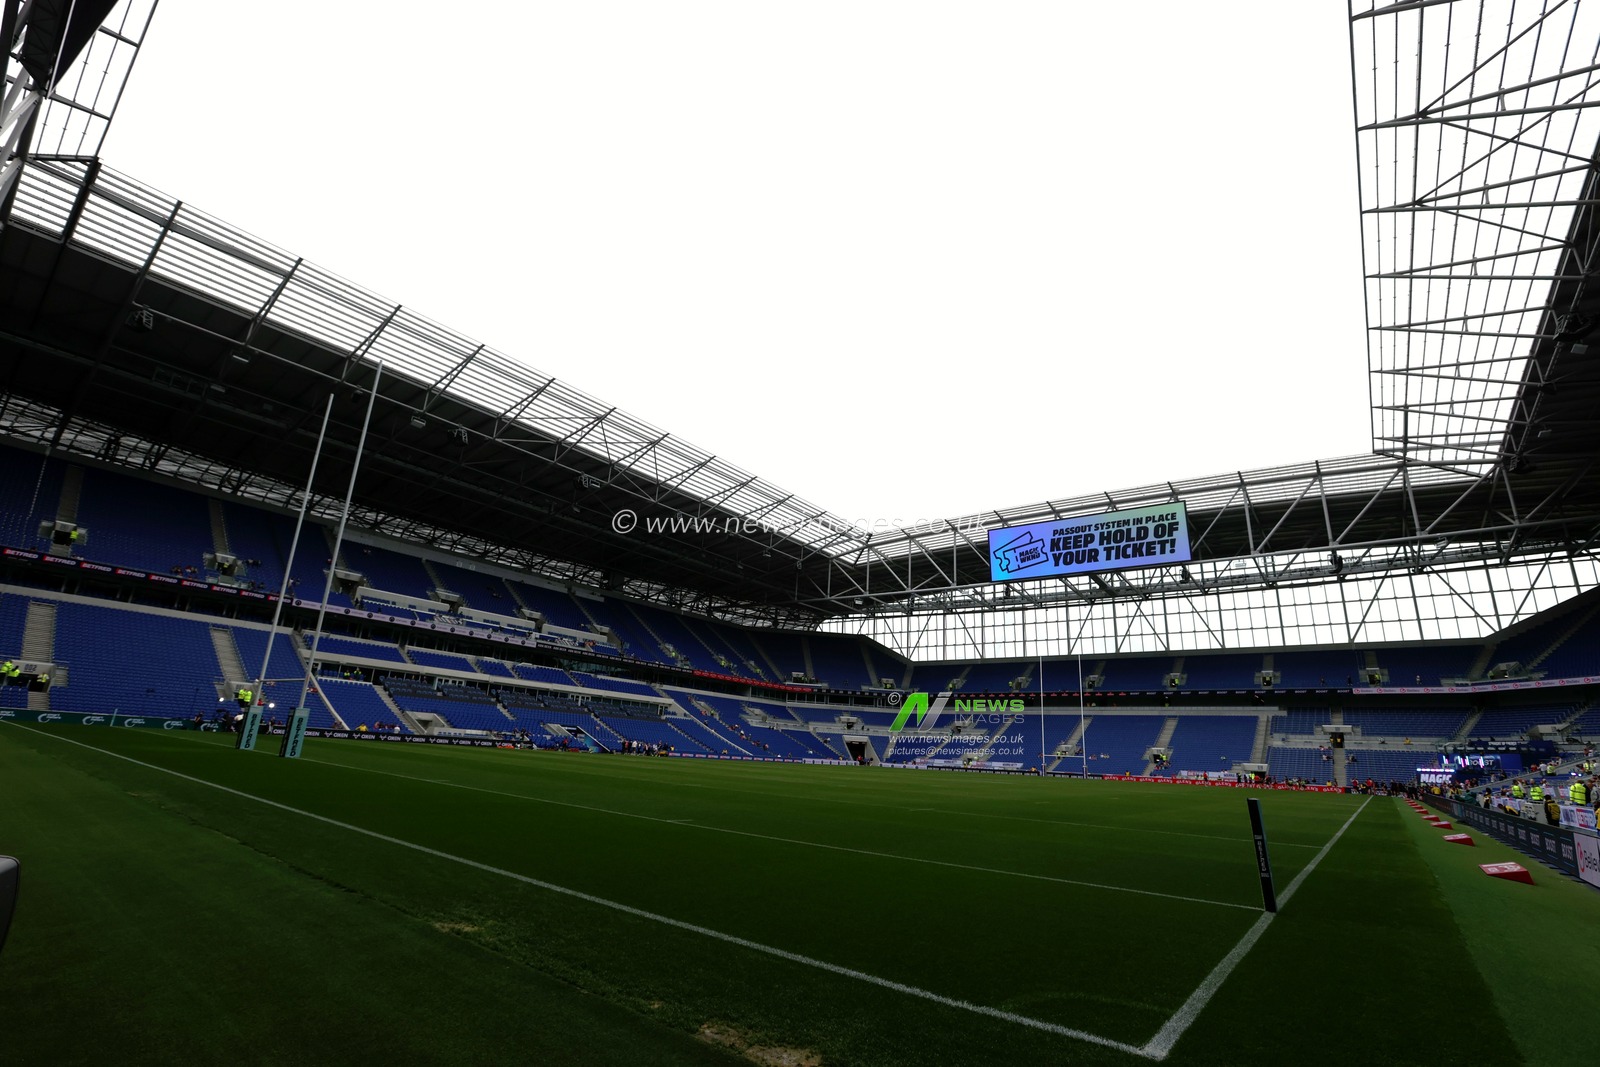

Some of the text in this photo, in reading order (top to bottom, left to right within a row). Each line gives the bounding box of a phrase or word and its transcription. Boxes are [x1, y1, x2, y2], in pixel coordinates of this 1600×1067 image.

[1053, 524, 1092, 536] PASSOUT
[1094, 519, 1130, 531] SYSTEM
[1145, 512, 1176, 524] PLACE
[1050, 521, 1179, 552] KEEP HOLD OF
[1019, 547, 1039, 557] MAGIC
[1052, 538, 1176, 566] YOUR TICKET!
[45, 556, 76, 566] BETFRED
[82, 562, 112, 572] BETFRED
[118, 569, 146, 578] BETFRED
[290, 718, 303, 756] BETFRED
